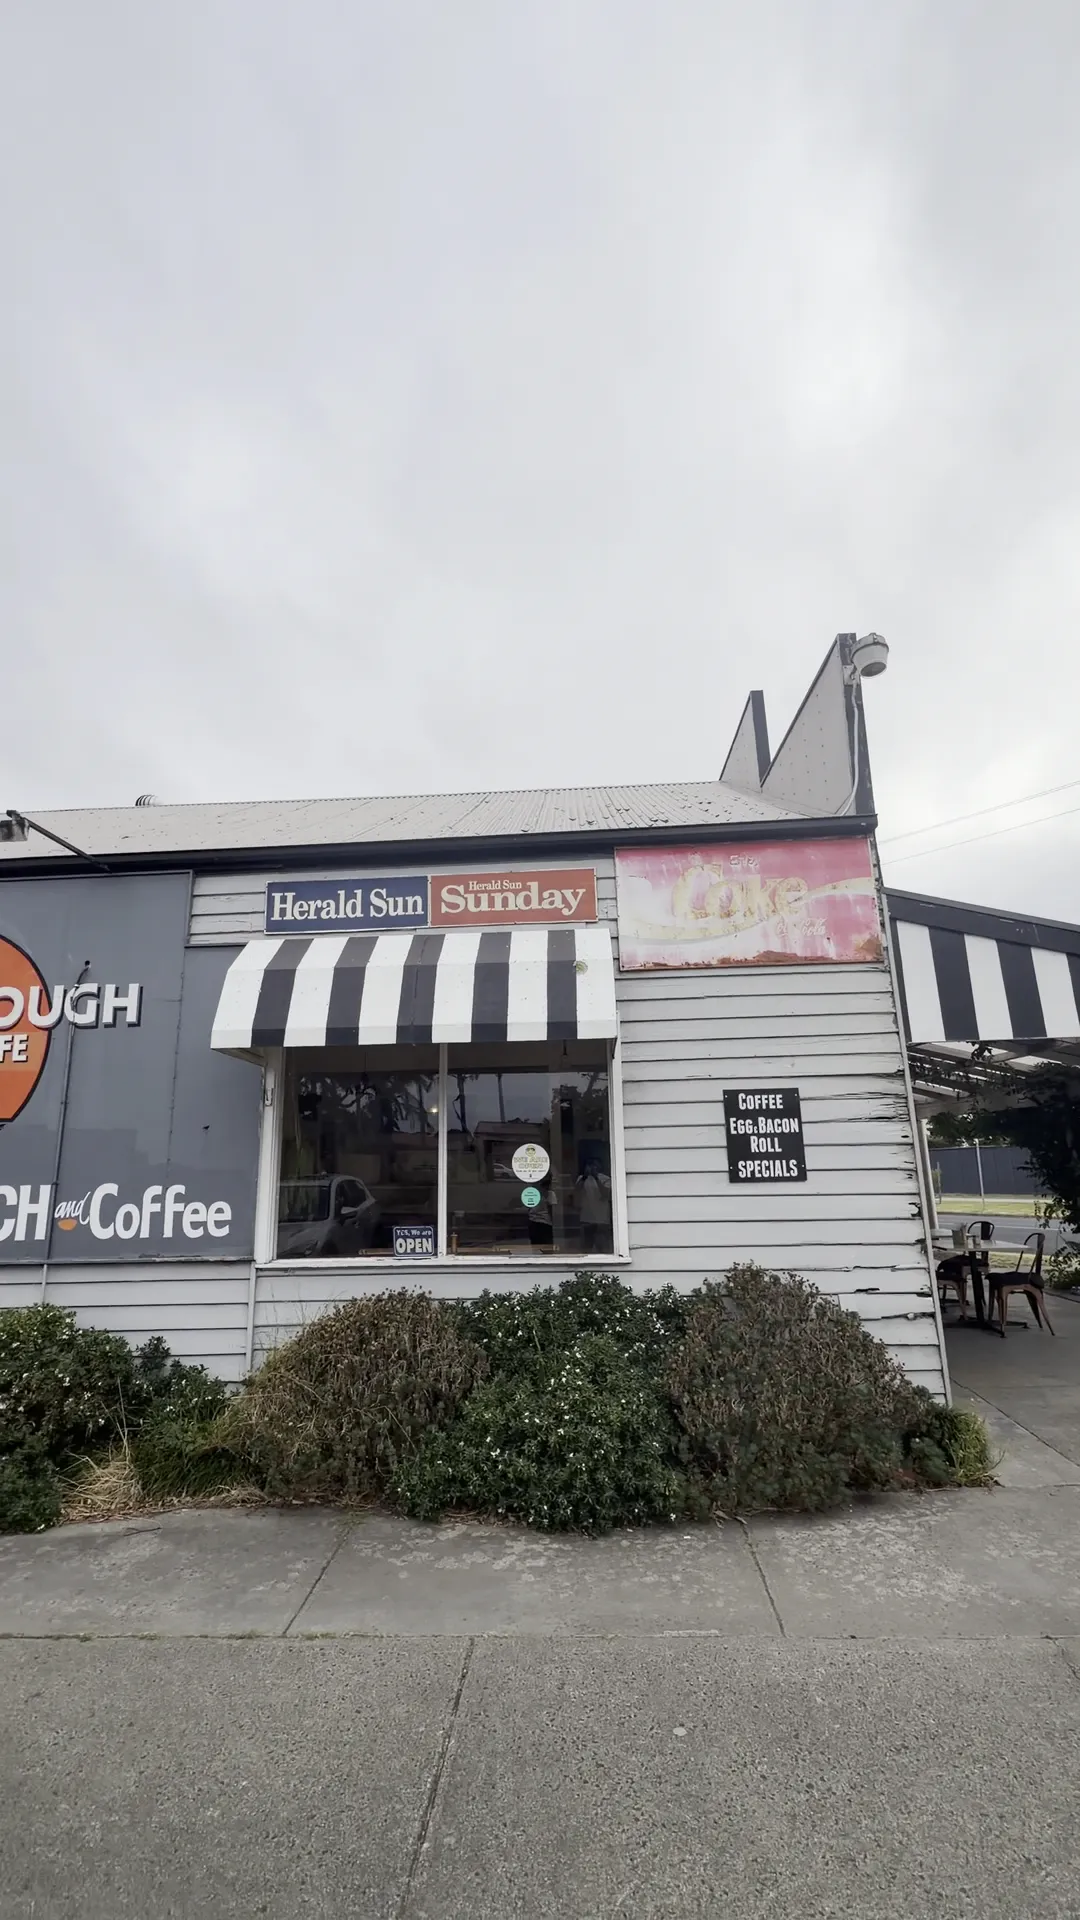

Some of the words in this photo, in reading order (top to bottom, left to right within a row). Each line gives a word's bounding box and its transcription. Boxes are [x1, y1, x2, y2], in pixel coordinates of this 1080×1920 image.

[468, 880, 500, 891] Herald
[502, 880, 522, 889] Sun
[672, 863, 808, 920] Coke
[271, 889, 363, 920] Herald
[370, 888, 424, 918] Sun
[441, 882, 586, 916] Sunday
[738, 1093, 783, 1110] COFFEE
[750, 1136, 782, 1152] ROLL
[738, 1160, 798, 1178] SPECIALS
[55, 1191, 91, 1225] and
[90, 1182, 232, 1240] Coffee
[396, 1238, 432, 1253] OPEN
